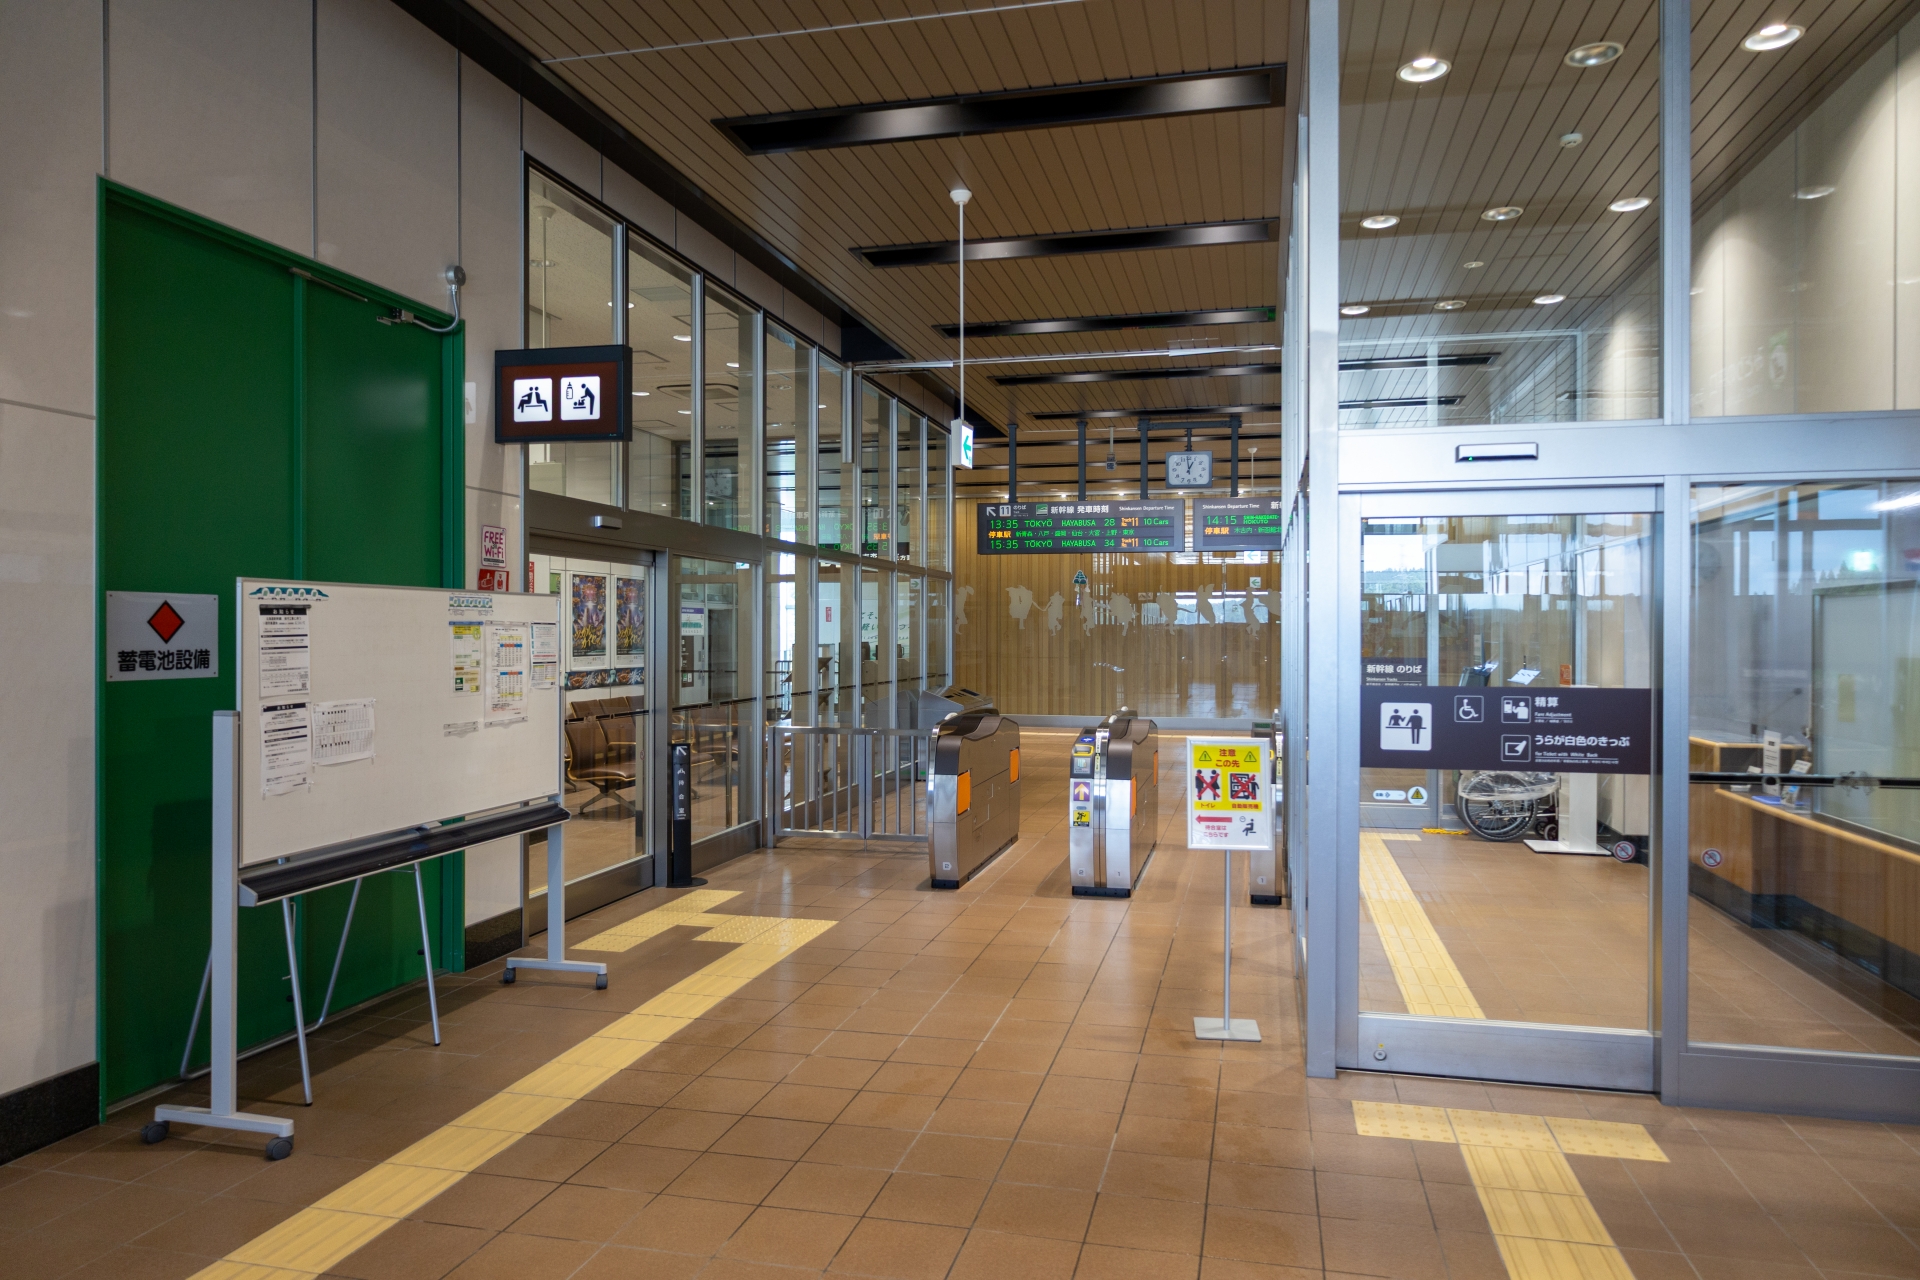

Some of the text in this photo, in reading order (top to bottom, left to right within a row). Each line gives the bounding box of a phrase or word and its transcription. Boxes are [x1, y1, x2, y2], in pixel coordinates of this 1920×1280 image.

[1051, 505, 1109, 514] 新幹線 発車時刻
[1271, 501, 1281, 509] 新
[1001, 507, 1010, 515] 11
[991, 520, 1018, 529] 13:35
[1104, 518, 1115, 526] 28
[1153, 517, 1169, 525] Cars
[1207, 515, 1237, 525] 14:15
[484, 531, 503, 544] FREE
[1153, 538, 1169, 546] Cars
[991, 540, 1018, 549] 15:35
[1062, 539, 1096, 547] HAYABUSA
[1104, 539, 1115, 547] 34
[484, 544, 504, 558] Wi-Fi
[117, 649, 211, 672] 蓄電池設備
[1366, 664, 1422, 674] 新幹線 のりば
[1534, 696, 1559, 707] 精算
[1534, 735, 1630, 747] うらが白色のきっぷ
[1219, 749, 1236, 757] 注意
[1215, 760, 1240, 768] この先
